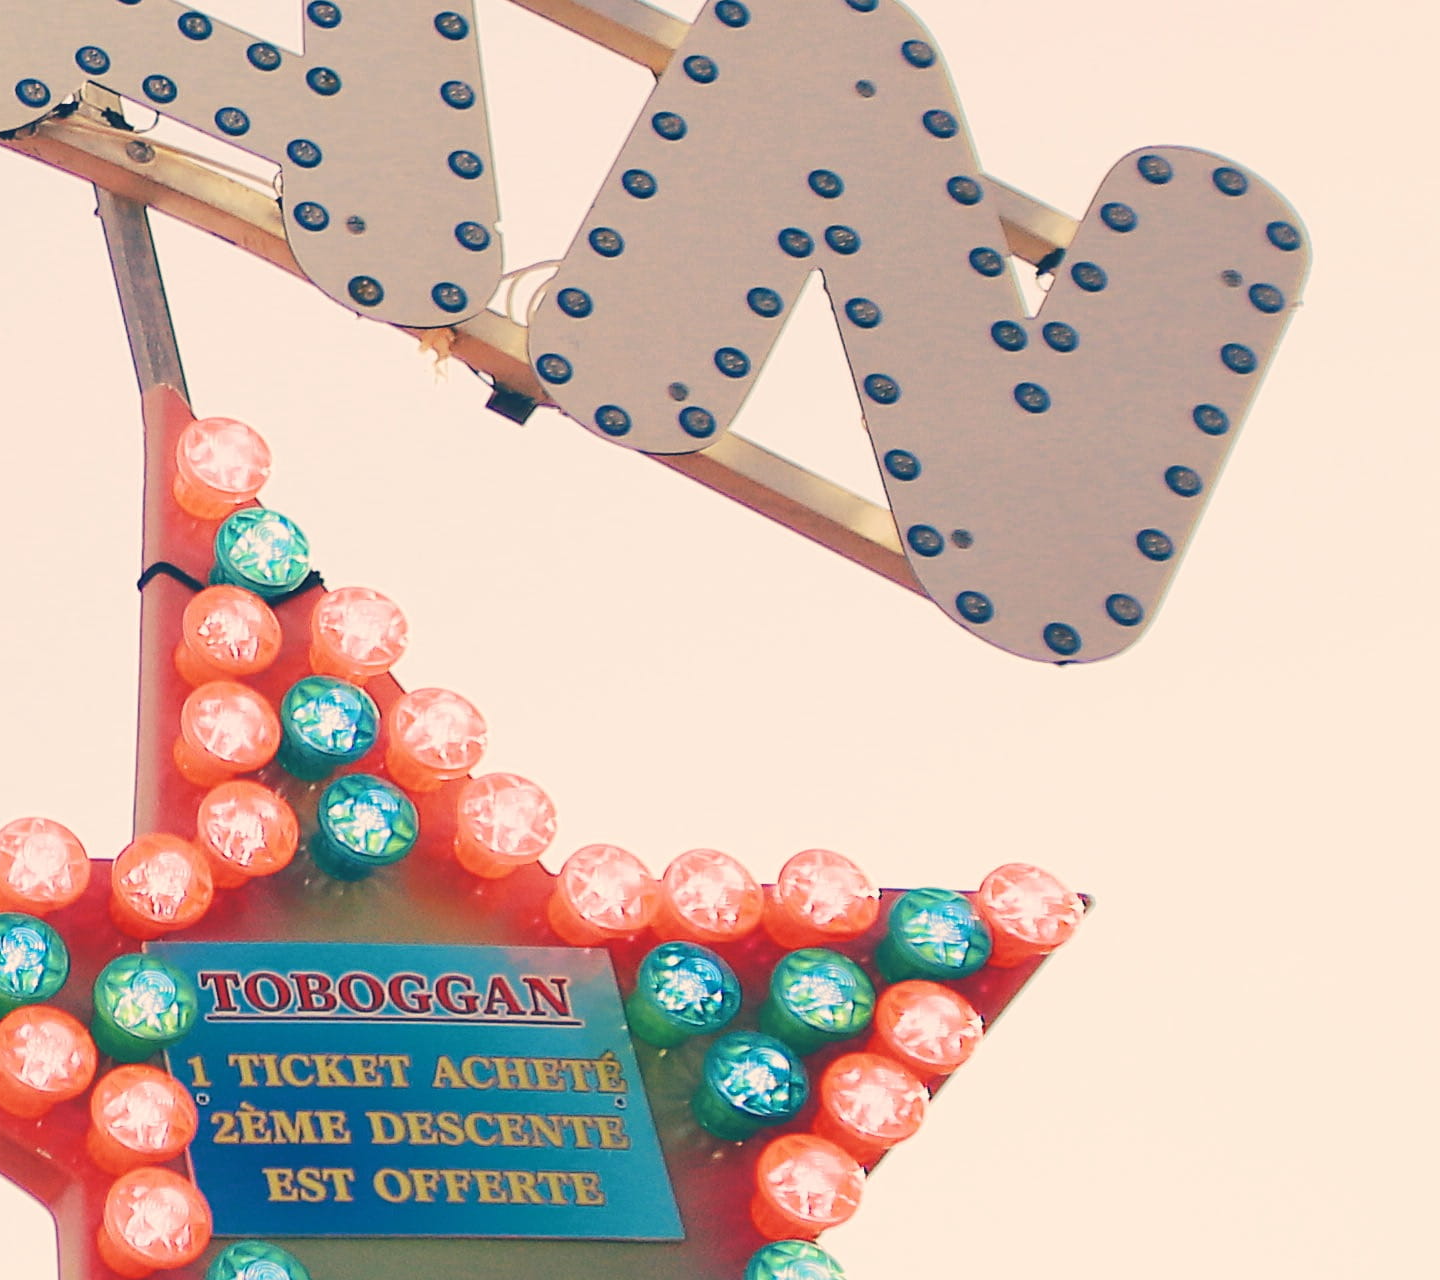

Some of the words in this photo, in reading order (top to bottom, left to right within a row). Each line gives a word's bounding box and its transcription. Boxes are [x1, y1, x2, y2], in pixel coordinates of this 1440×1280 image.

[201, 971, 569, 1017] TOBOGGAN
[188, 1056, 211, 1087] 1
[229, 1053, 410, 1089] TICKET
[433, 1051, 627, 1093] ACHETÉ
[211, 1102, 352, 1145] 2ÈME
[366, 1111, 630, 1150] DESCENTE
[263, 1168, 355, 1202] EST
[373, 1168, 605, 1207] OFFERTE
